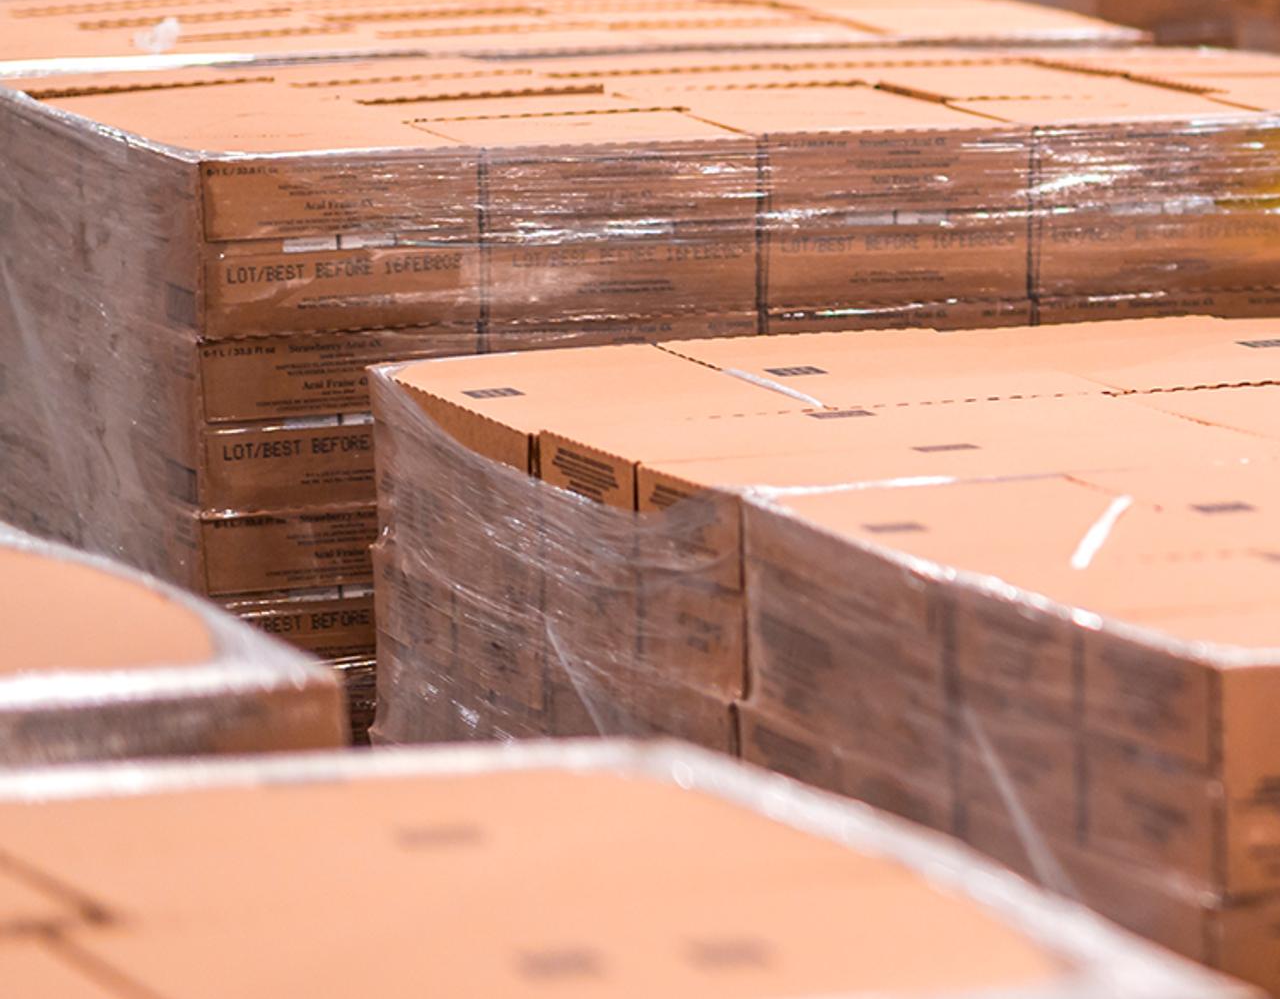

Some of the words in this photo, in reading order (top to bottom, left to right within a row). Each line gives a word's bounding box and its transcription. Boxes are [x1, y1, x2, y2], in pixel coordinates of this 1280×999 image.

[227, 263, 305, 285] LOT/BEST
[315, 258, 373, 280] BEFORE
[223, 438, 304, 462] LOT/BEST
[312, 434, 370, 455] BEFORE
[312, 608, 370, 630] BEFORE
